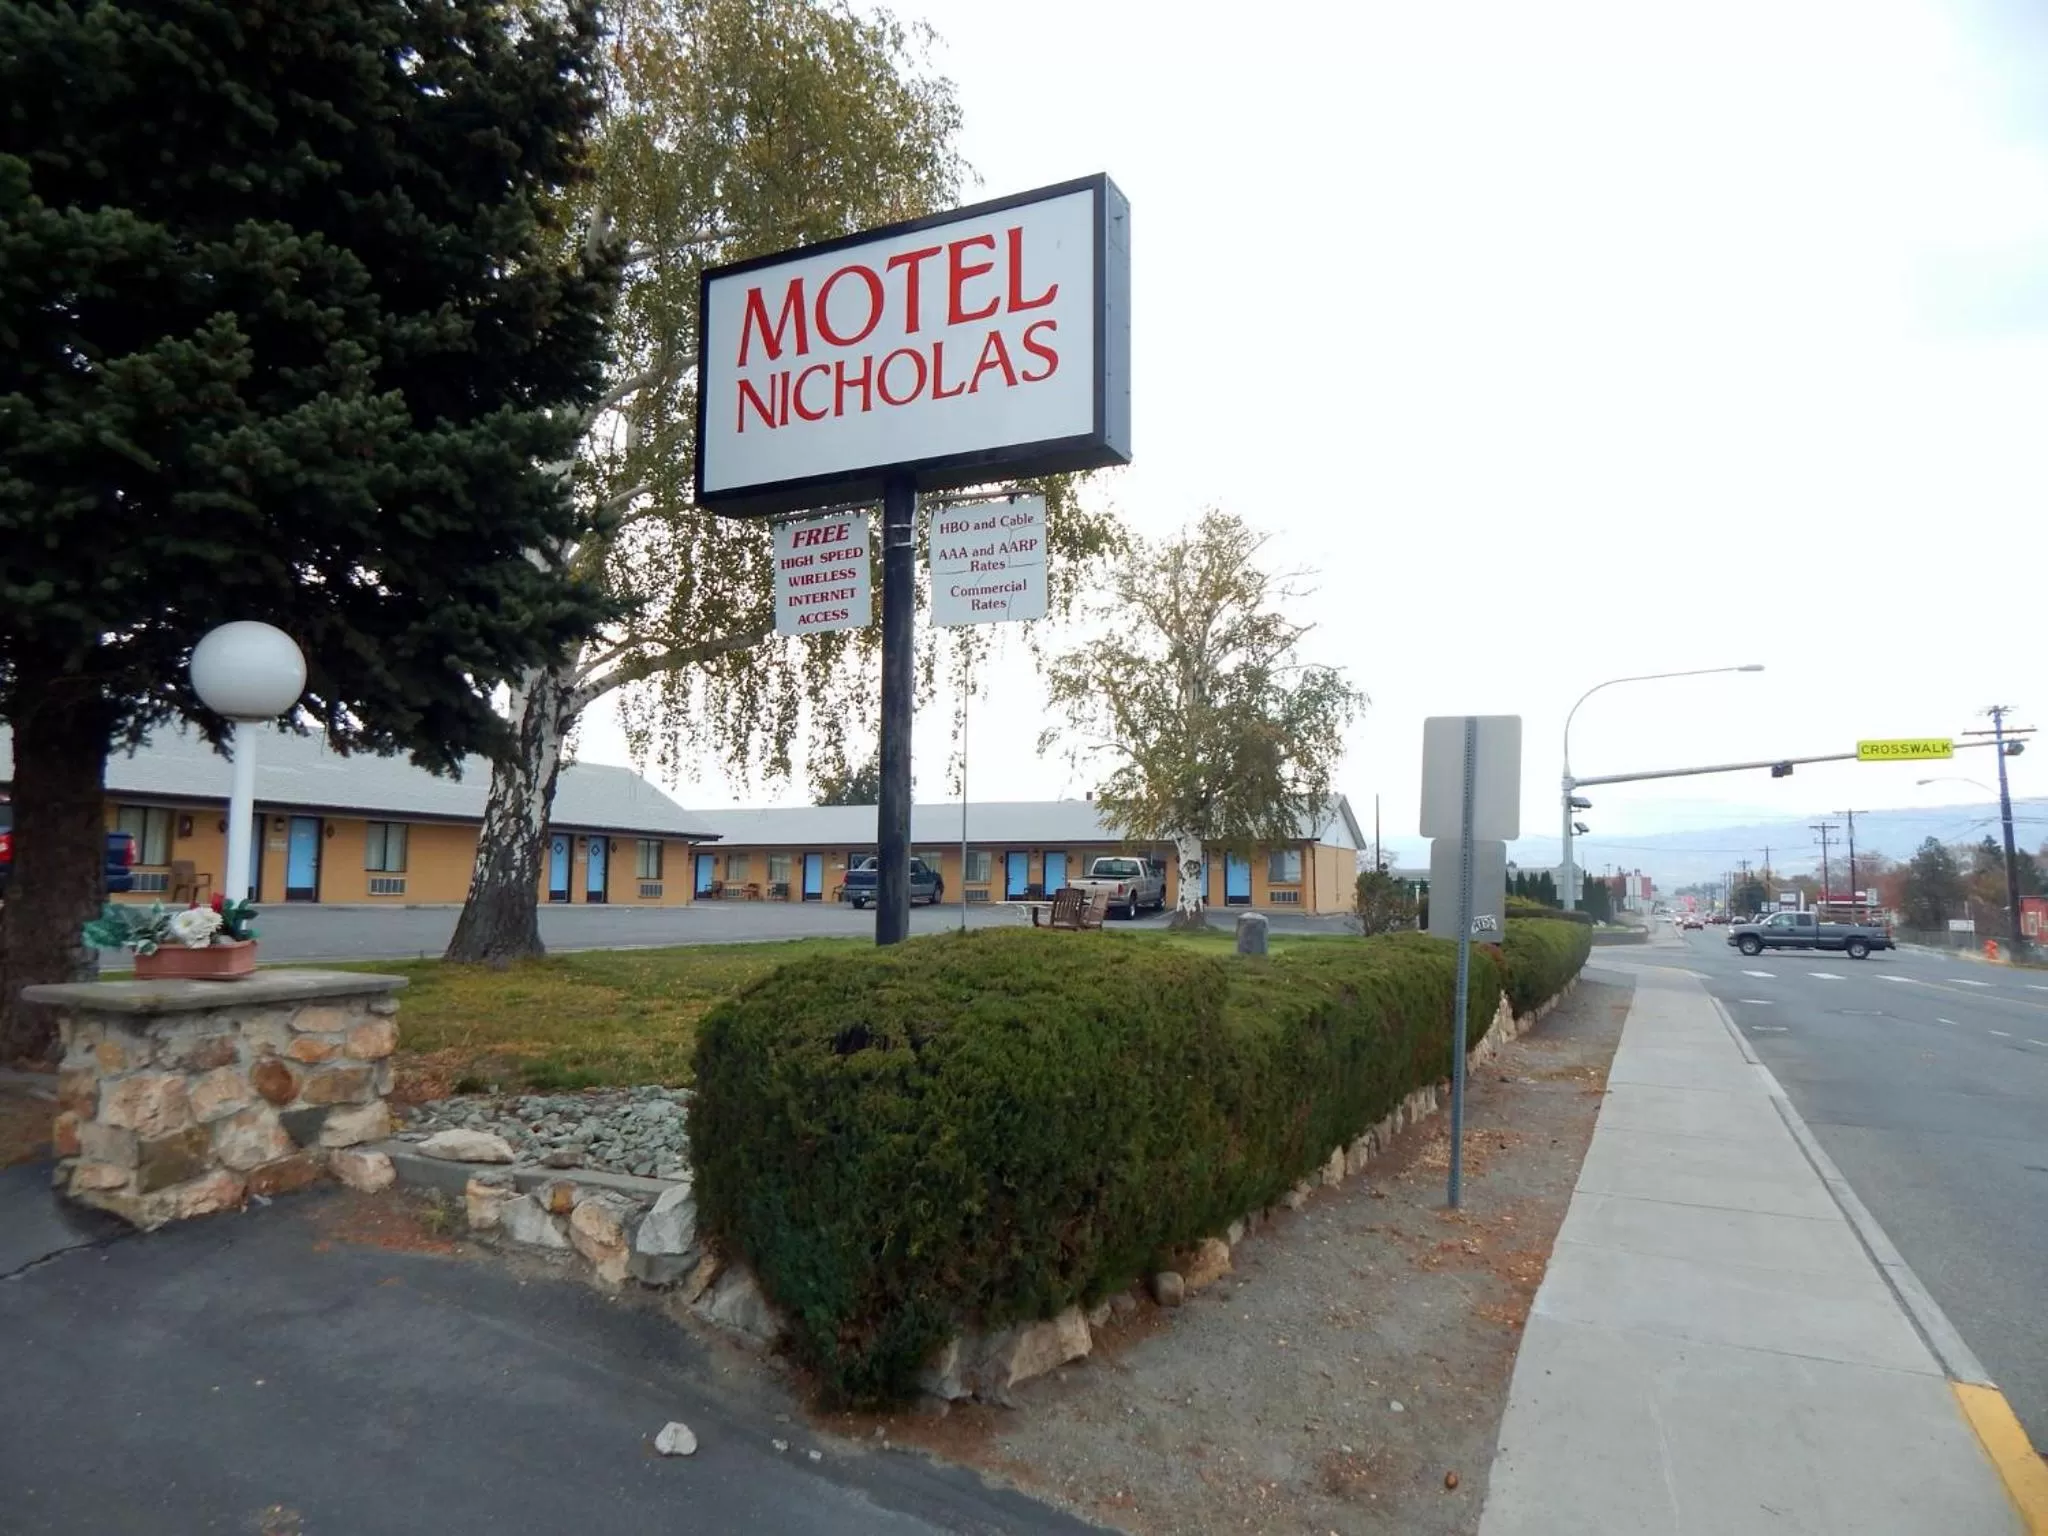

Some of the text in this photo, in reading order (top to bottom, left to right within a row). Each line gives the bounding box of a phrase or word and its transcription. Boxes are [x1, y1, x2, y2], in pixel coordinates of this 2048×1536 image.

[737, 226, 1058, 368] MOTEL
[736, 319, 1060, 433] NICHOLAS
[940, 513, 1034, 534] HBO and Cable
[791, 522, 850, 548] FREE
[780, 547, 863, 570] HIGH SPEED
[938, 538, 1037, 560] AAA and AARP
[970, 559, 1006, 572] Rates
[788, 568, 856, 587] WIRELESS
[950, 578, 1027, 597] Commercial
[788, 588, 856, 607] INTERNET
[971, 597, 1007, 611] Rates
[798, 608, 849, 625] ACCESS
[1861, 742, 1951, 755] CROSSWALK
